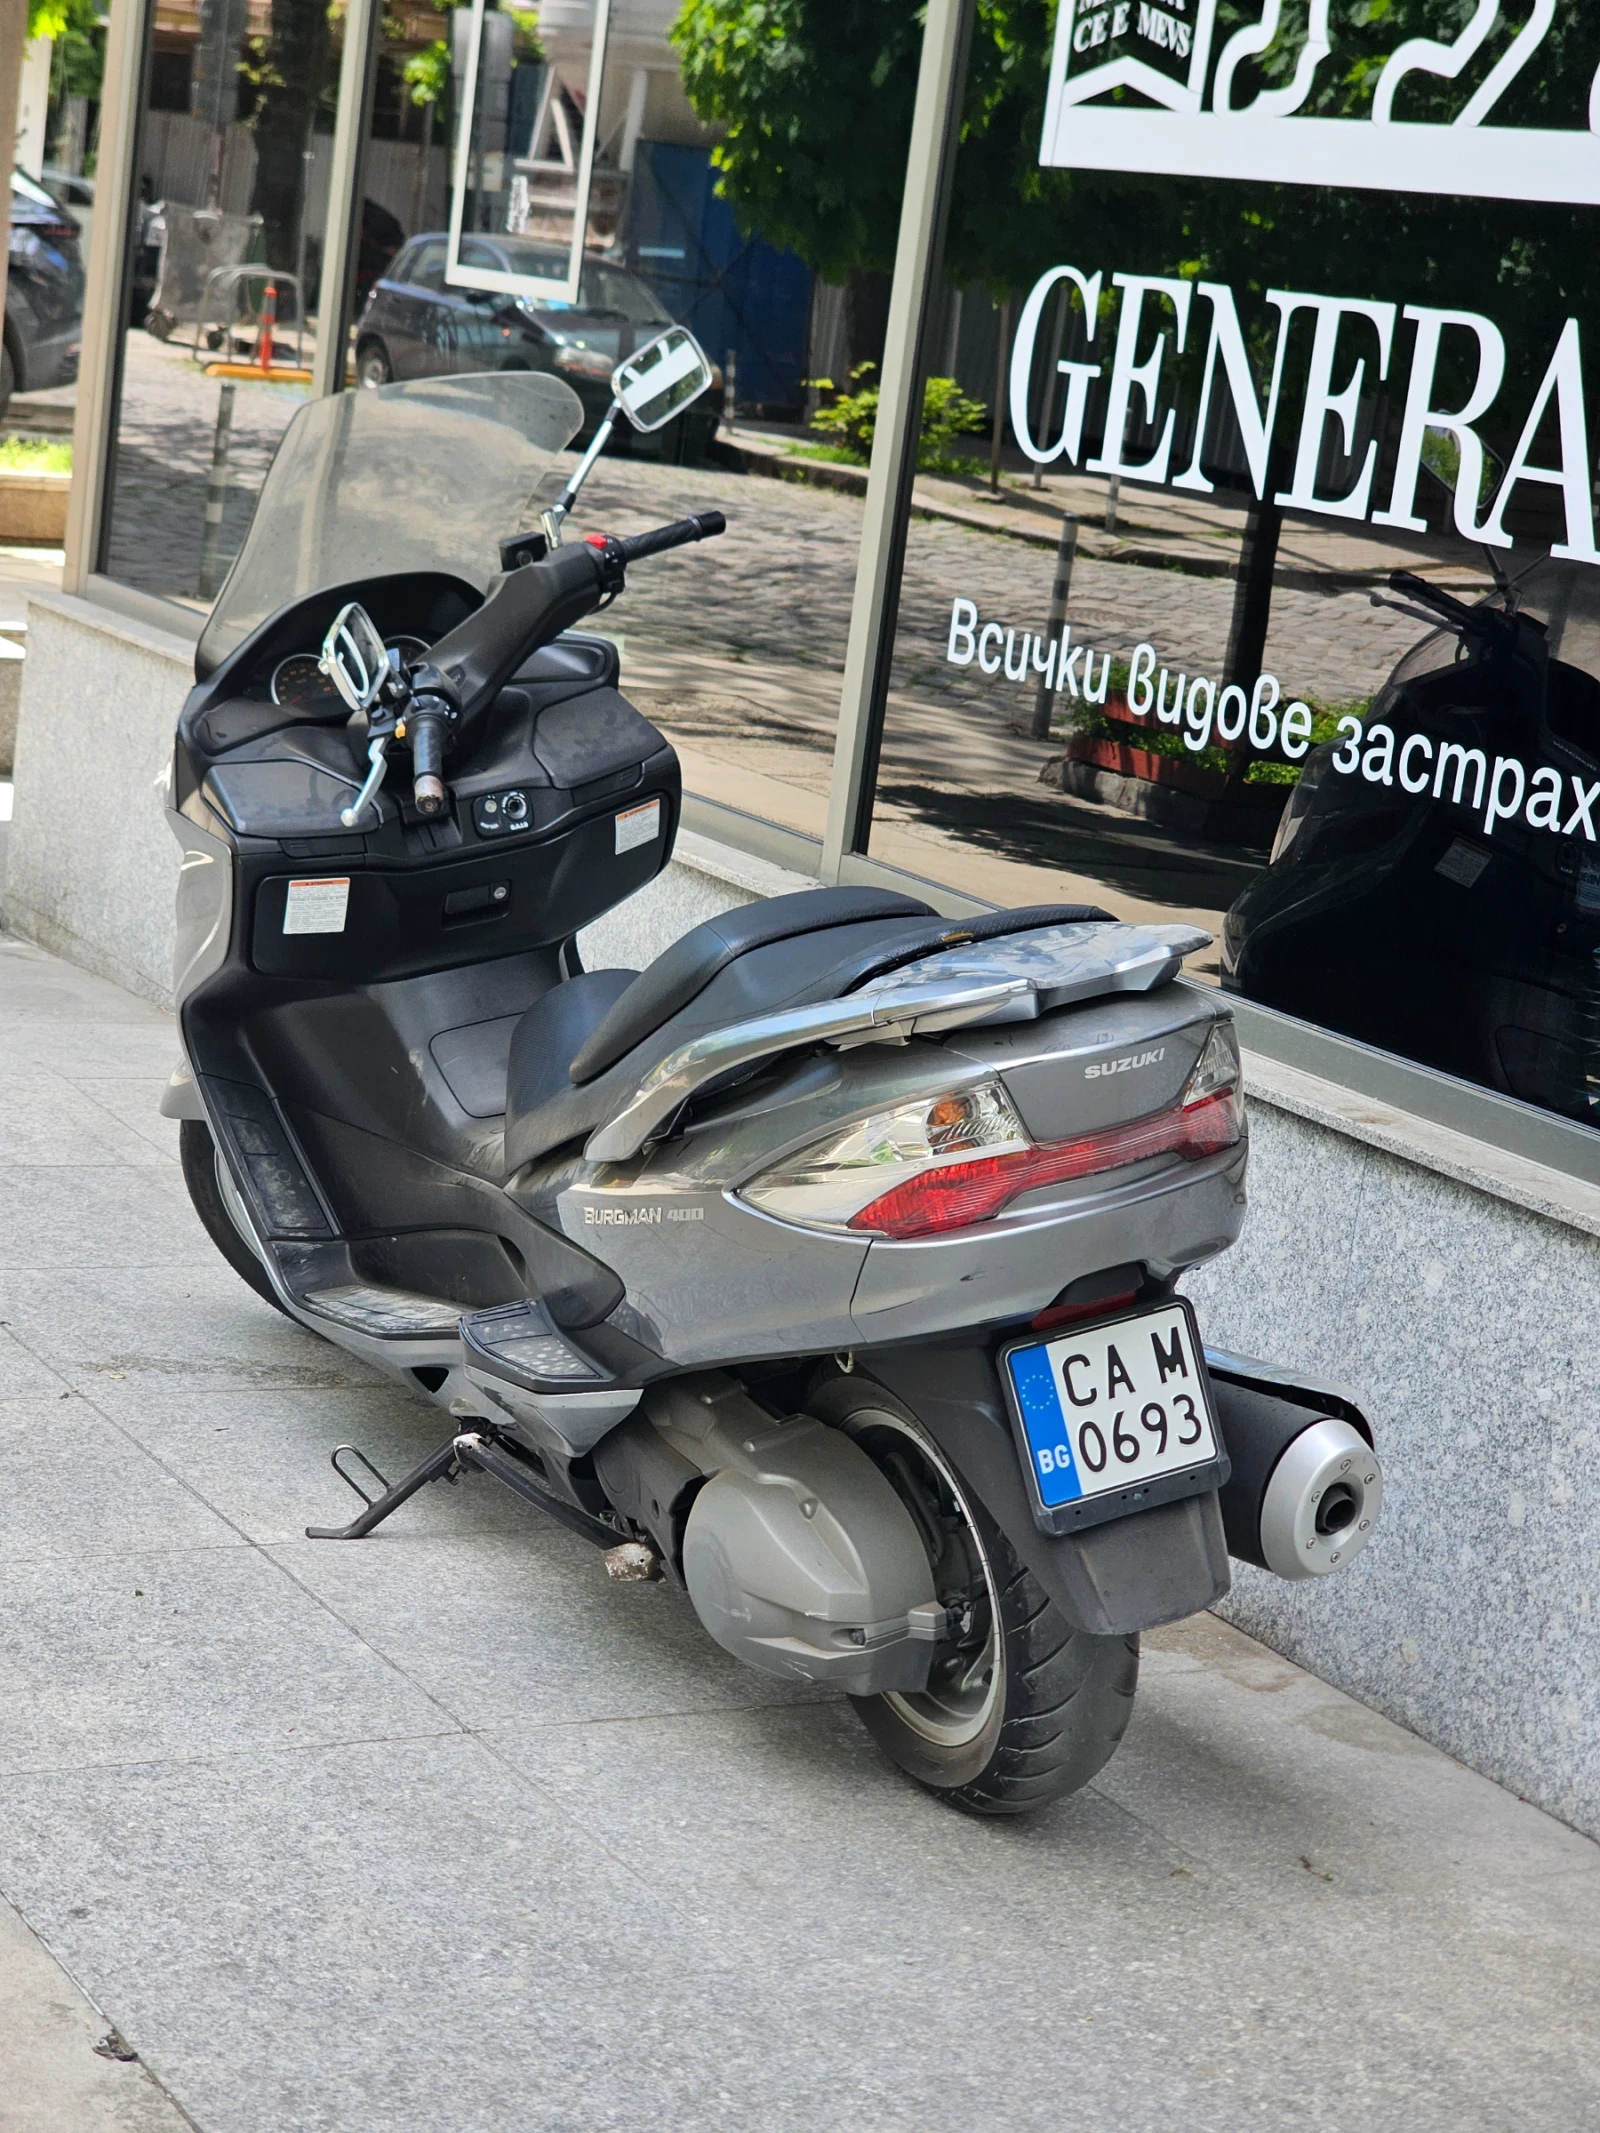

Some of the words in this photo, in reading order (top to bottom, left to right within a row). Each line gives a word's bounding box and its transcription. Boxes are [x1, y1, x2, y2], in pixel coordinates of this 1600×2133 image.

[1136, 0, 1192, 58] MEVS
[1009, 265, 1600, 567] GENERA
[947, 597, 1111, 704] Всички
[1127, 643, 1313, 759] видове
[1332, 715, 1600, 842] застрах
[1084, 1047, 1165, 1079] SUZUKI
[583, 1206, 662, 1226] BURGMAN
[666, 1207, 704, 1222] 400
[1062, 1344, 1136, 1407] CA
[1150, 1326, 1189, 1384] M
[1037, 1444, 1071, 1475] BG
[1078, 1393, 1202, 1473] 0693
